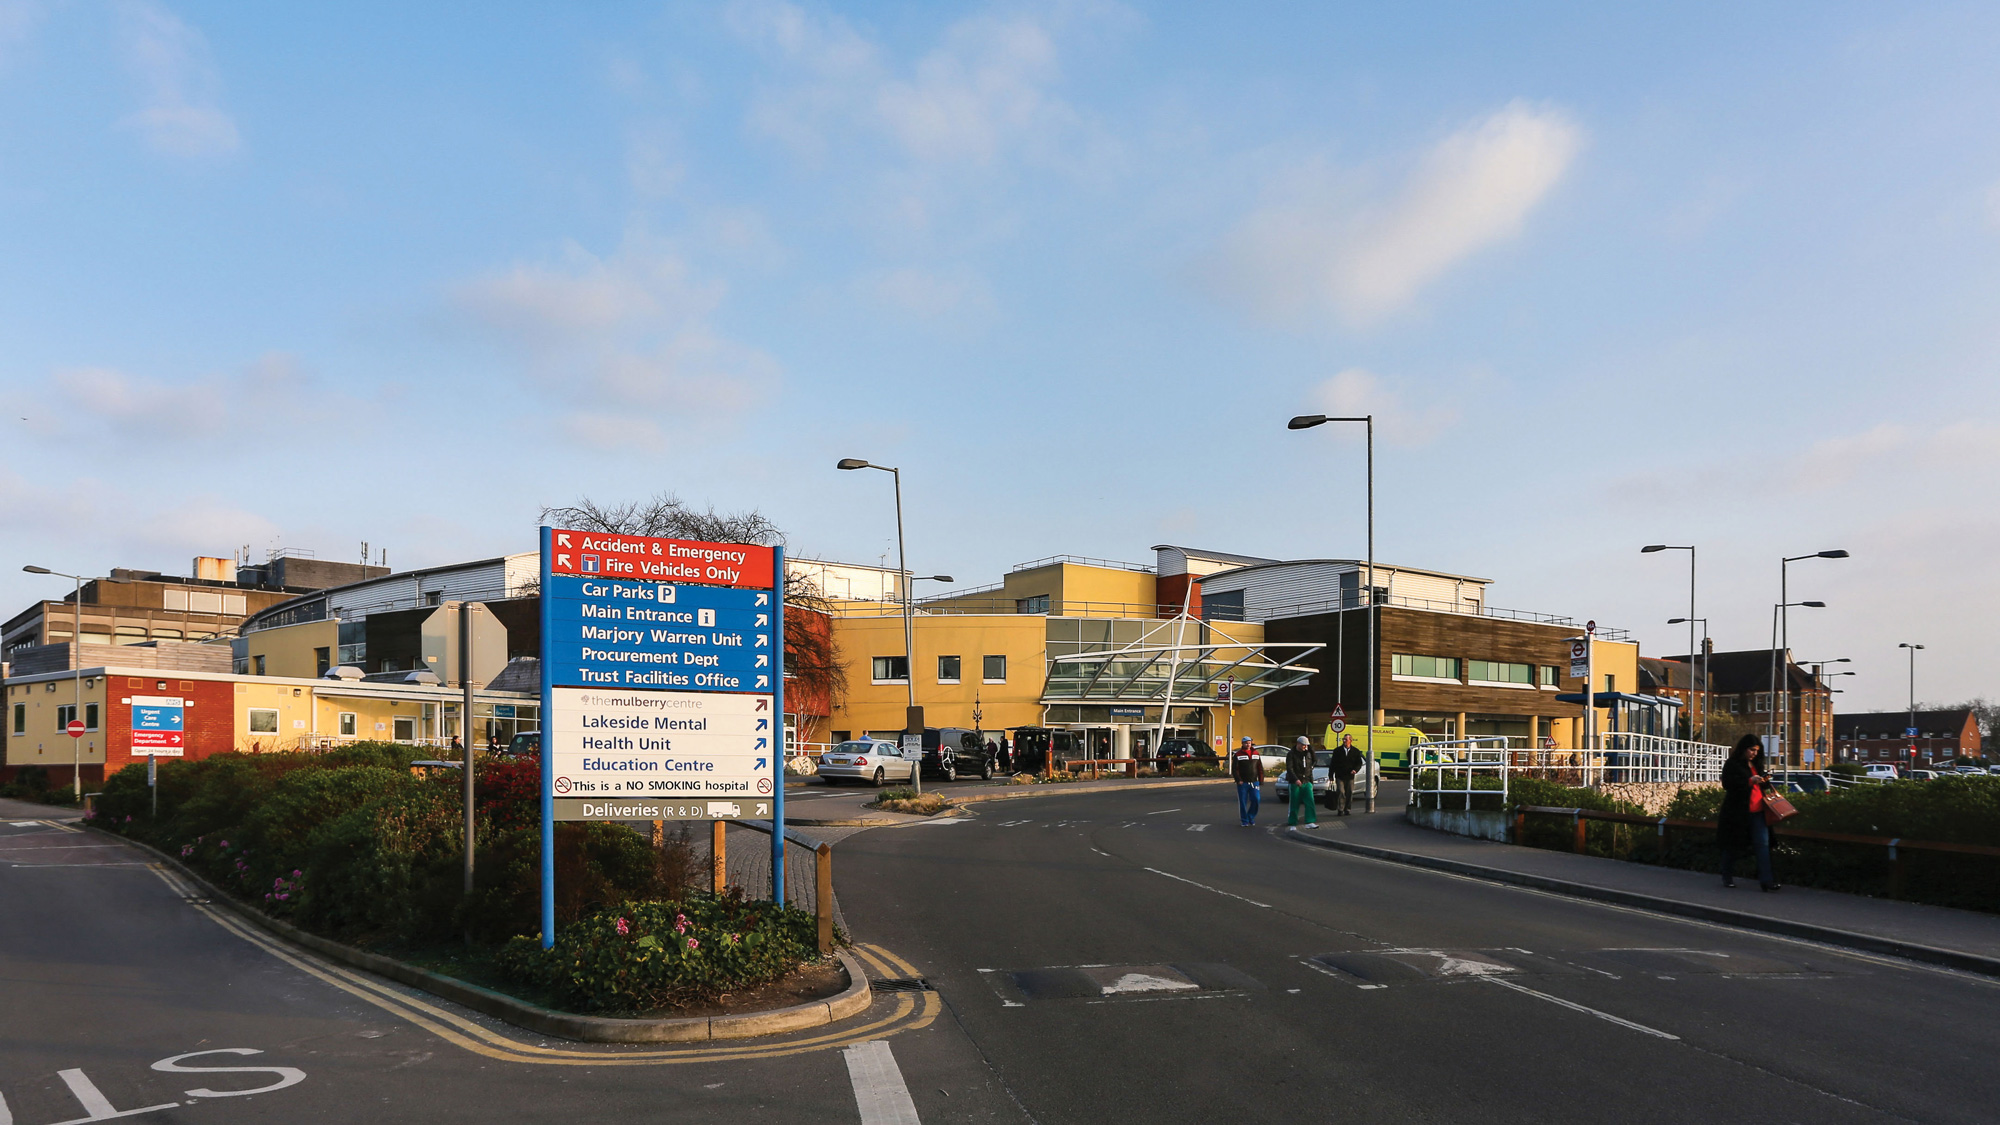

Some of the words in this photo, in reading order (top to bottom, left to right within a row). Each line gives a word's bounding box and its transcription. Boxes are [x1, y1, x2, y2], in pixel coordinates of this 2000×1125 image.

[581, 536, 646, 555] Accident
[651, 542, 663, 556] &
[669, 544, 746, 566] Emergency
[605, 558, 634, 573] Fire
[640, 561, 700, 578] Vehicles
[706, 566, 741, 583] Only
[581, 582, 609, 598] Car
[613, 584, 654, 600] Parks
[662, 587, 672, 600] P
[581, 604, 621, 619] Main
[626, 606, 693, 623] Entrance
[581, 625, 645, 645] Marjory
[650, 629, 706, 645] Warren
[711, 632, 742, 647] Unit
[581, 647, 678, 665] Procurement
[683, 651, 719, 668] Dept
[578, 668, 619, 683] Trust
[625, 670, 689, 685] Facilities
[694, 672, 740, 688] Office
[591, 695, 703, 710] themulberrycentre
[582, 714, 650, 730] Lakeside
[654, 716, 707, 731] Mental
[582, 736, 634, 750] Health
[639, 737, 671, 751] Unit
[582, 757, 659, 771] Education
[665, 758, 714, 772] Centre
[573, 780, 596, 791] This
[600, 780, 610, 791] is
[614, 783, 621, 791] a
[626, 780, 644, 791] NO
[648, 780, 701, 791] SMOKING
[705, 780, 749, 793] hospital
[582, 802, 659, 817] Deliveries
[662, 804, 674, 818] (R
[678, 805, 687, 816] &
[690, 804, 704, 819] D)
